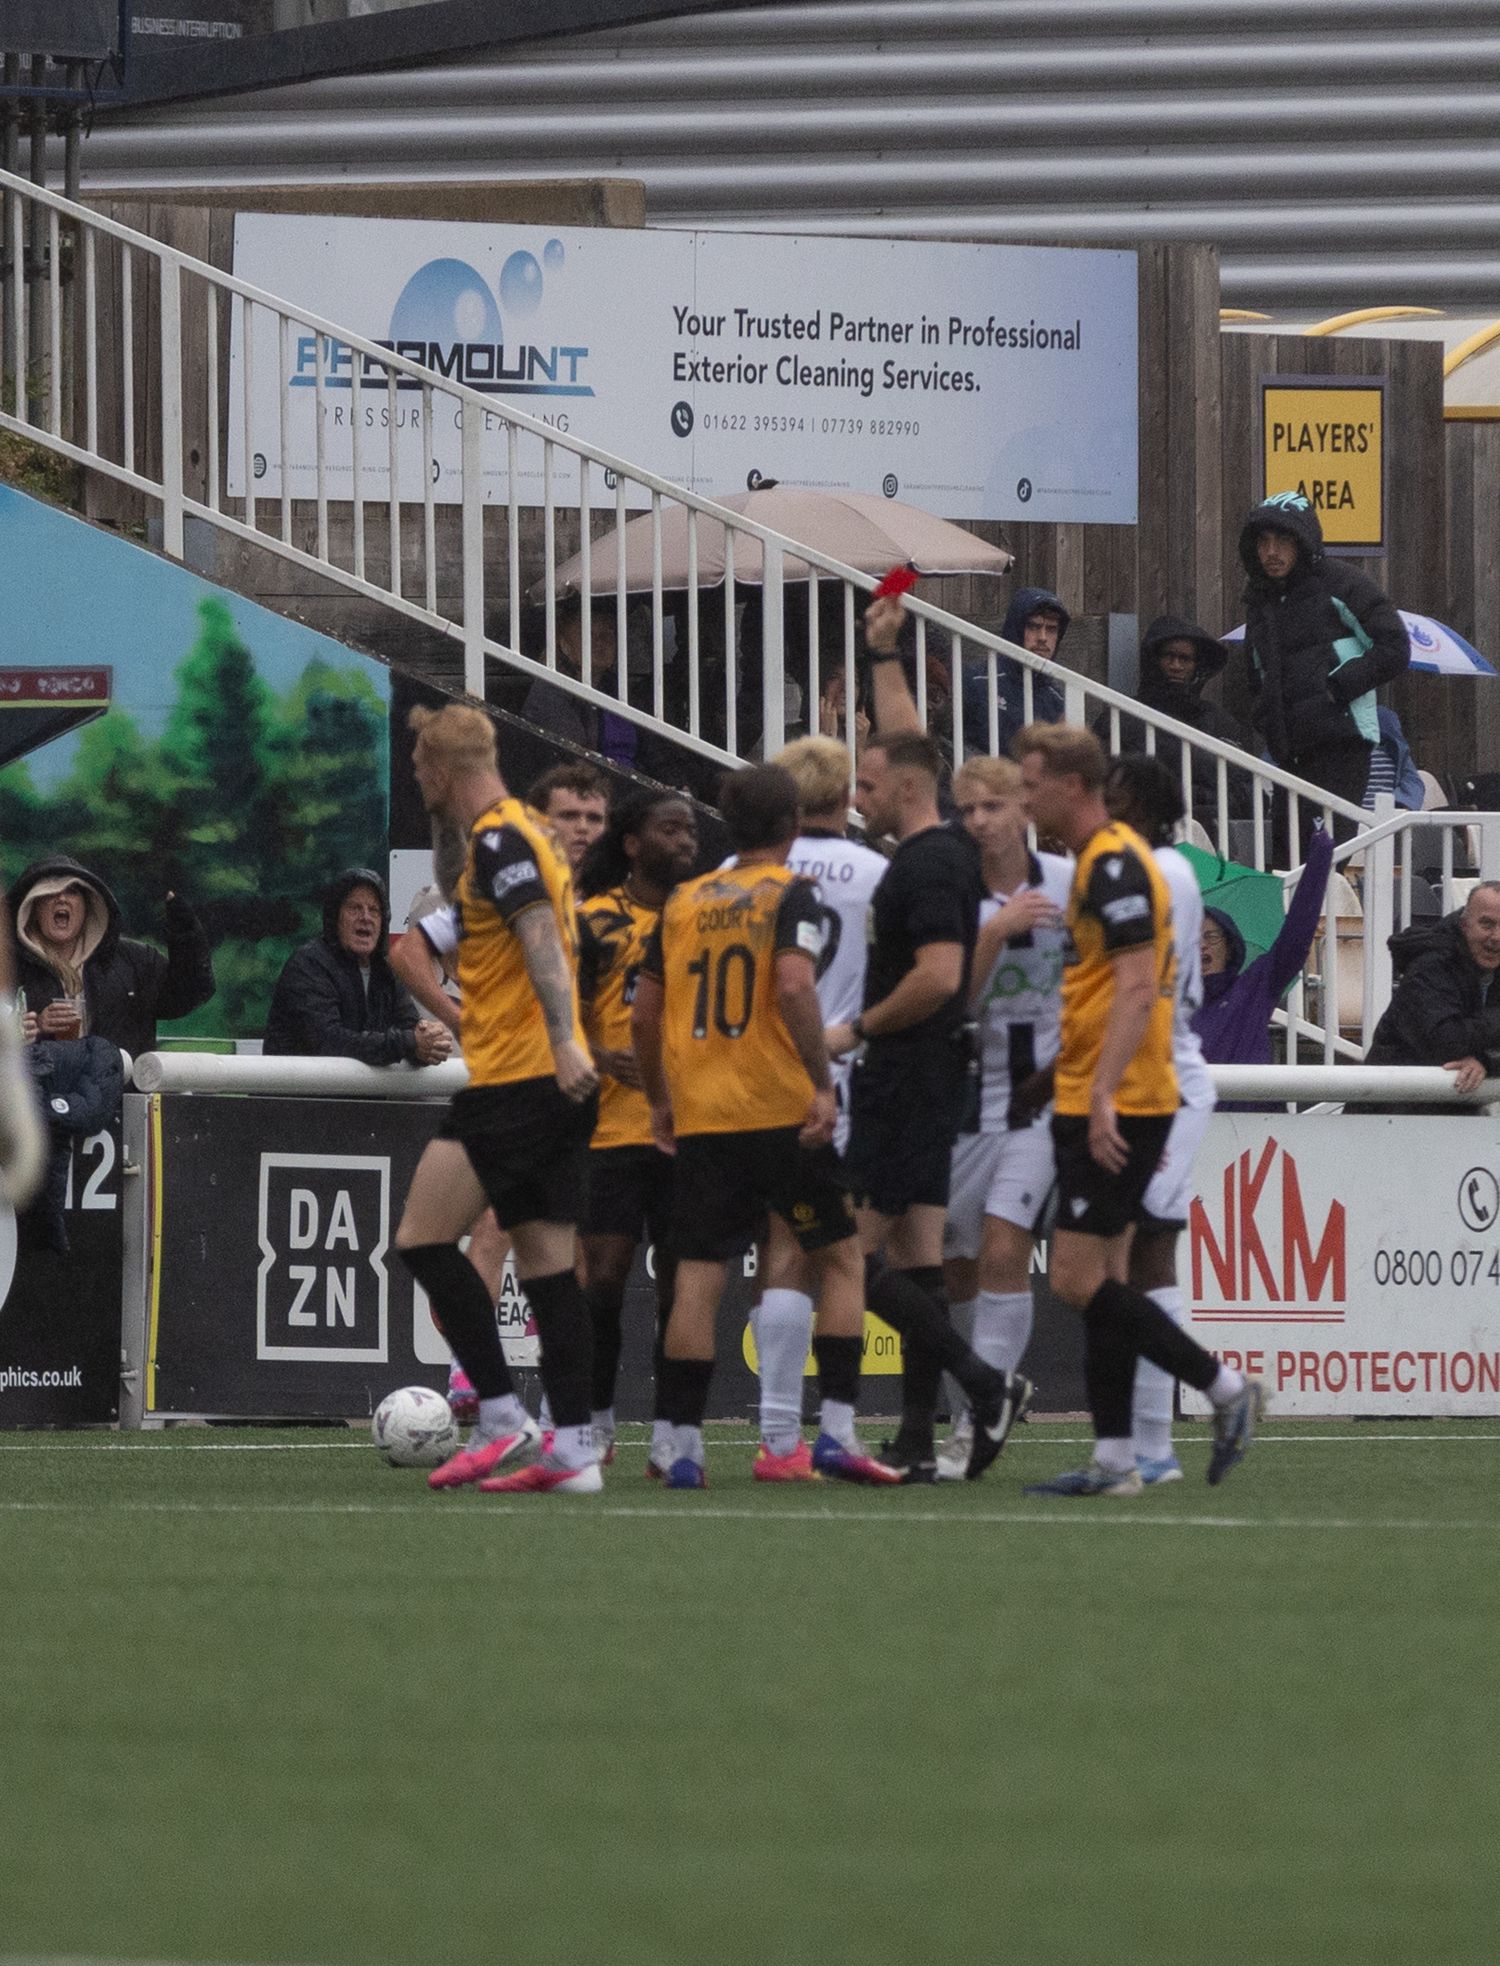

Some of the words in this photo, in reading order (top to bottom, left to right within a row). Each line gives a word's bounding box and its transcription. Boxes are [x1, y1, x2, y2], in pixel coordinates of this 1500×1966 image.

[672, 306, 726, 337] Your
[734, 308, 821, 341] Trusted
[830, 312, 914, 345] Partner
[921, 315, 941, 345] in
[949, 316, 1082, 351] Professional
[673, 352, 768, 385] Exterior
[776, 355, 874, 397] Cleaning
[883, 360, 981, 392] Services.
[703, 414, 746, 430] 01622
[753, 416, 804, 433] 395394
[821, 418, 863, 434] 07739
[870, 420, 920, 436] 882990
[1273, 422, 1374, 454] PLAYERS'
[687, 943, 756, 1040] 10
[1190, 1136, 1347, 1302] NKM
[1374, 1250, 1442, 1286] 0800
[1451, 1249, 1500, 1287] 074
[874, 1335, 895, 1356] on
[0, 1364, 83, 1393] phics.co.uk
[1277, 1350, 1500, 1393] PROTECTION
